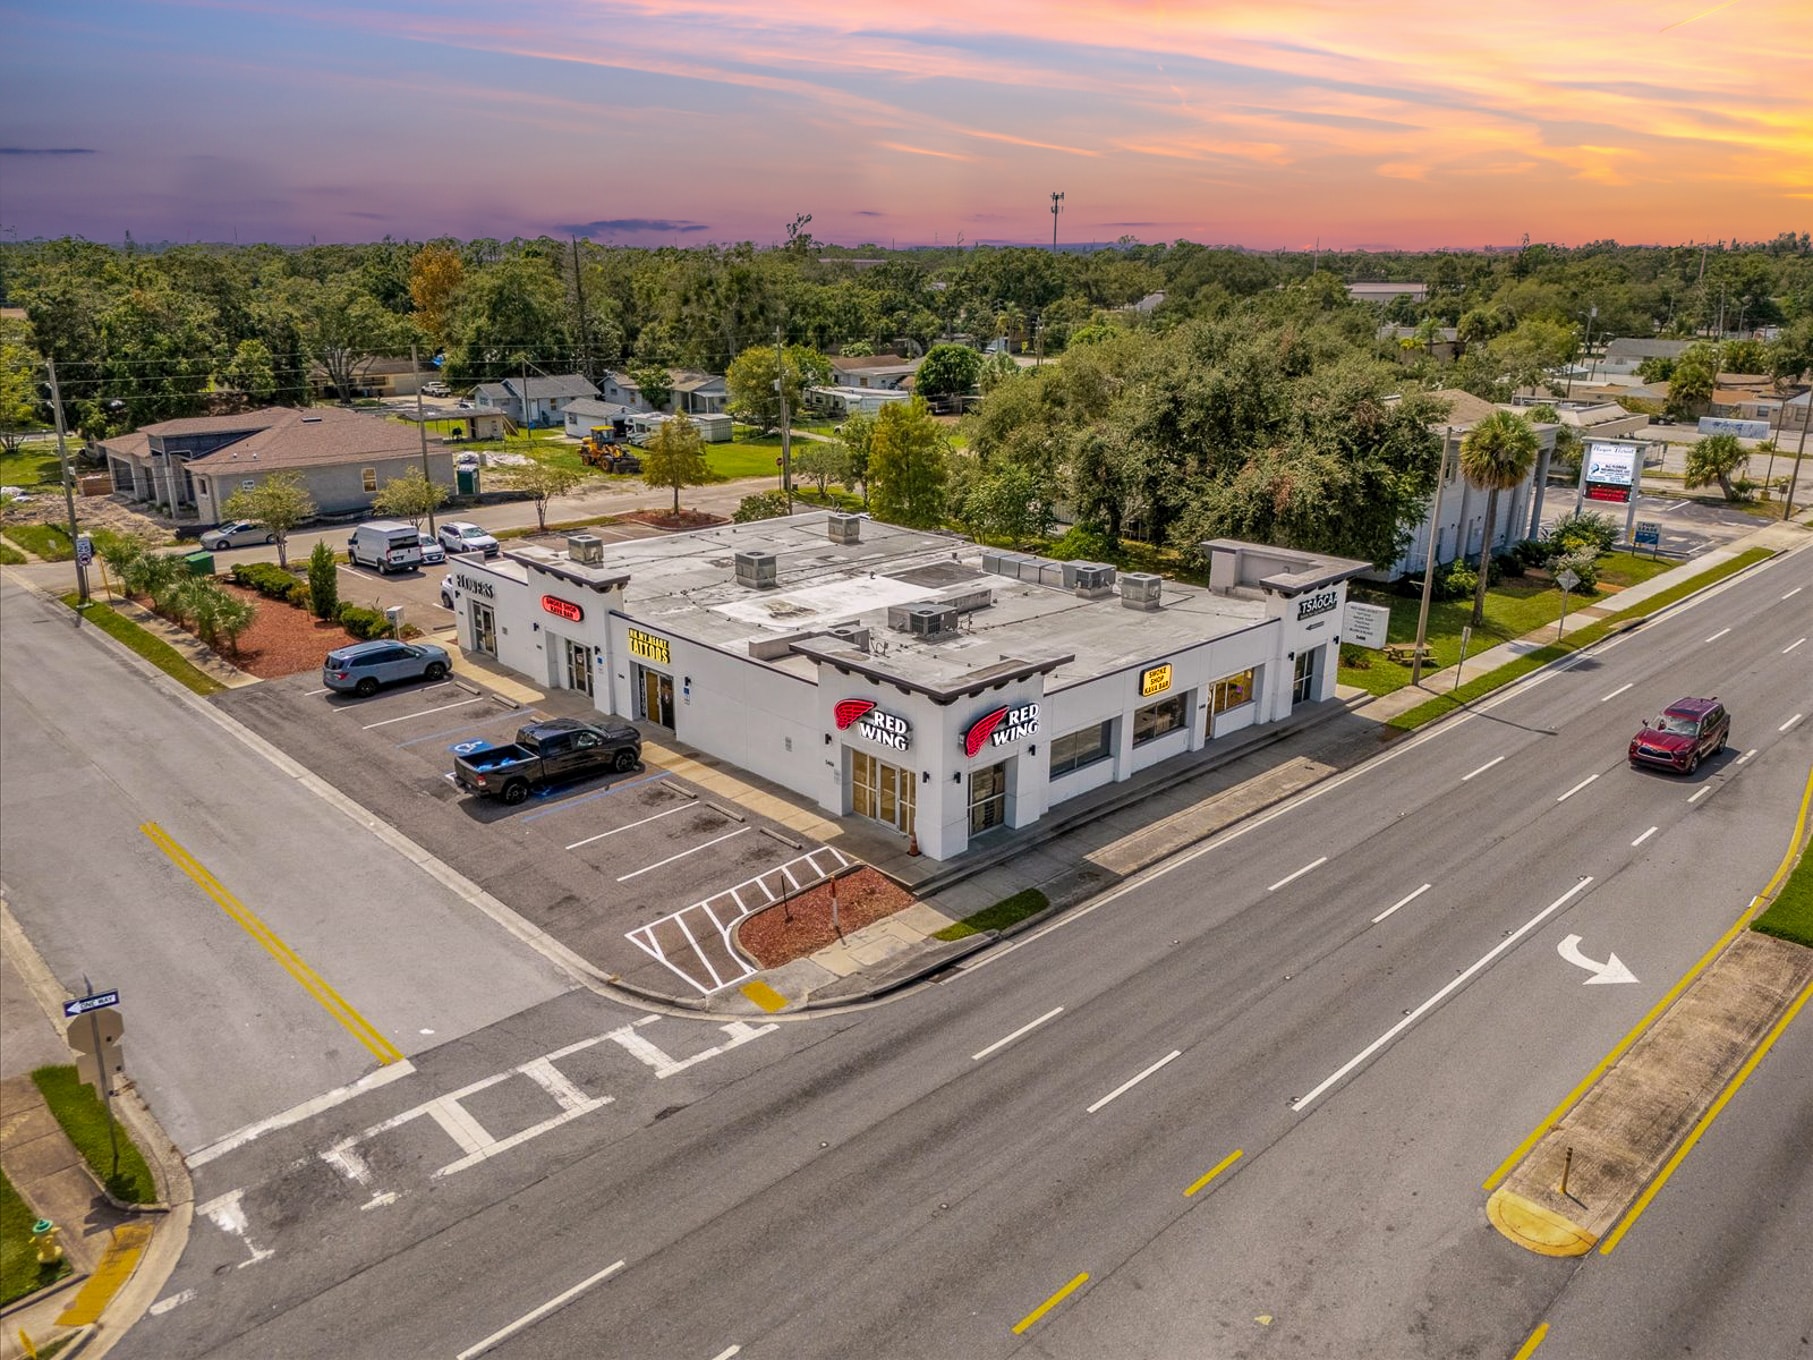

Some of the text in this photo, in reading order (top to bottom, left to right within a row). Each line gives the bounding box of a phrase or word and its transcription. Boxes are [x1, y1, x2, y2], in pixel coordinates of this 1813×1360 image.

[629, 637, 671, 664] TATTOOS
[1149, 666, 1167, 679] SMOKE
[1150, 675, 1165, 685] SHOP
[1158, 680, 1169, 690] BAR
[874, 709, 909, 735] RED
[1008, 702, 1041, 727] RED
[859, 722, 909, 752] WING
[991, 720, 1041, 748] WING
[80, 1001, 96, 1009] ONE
